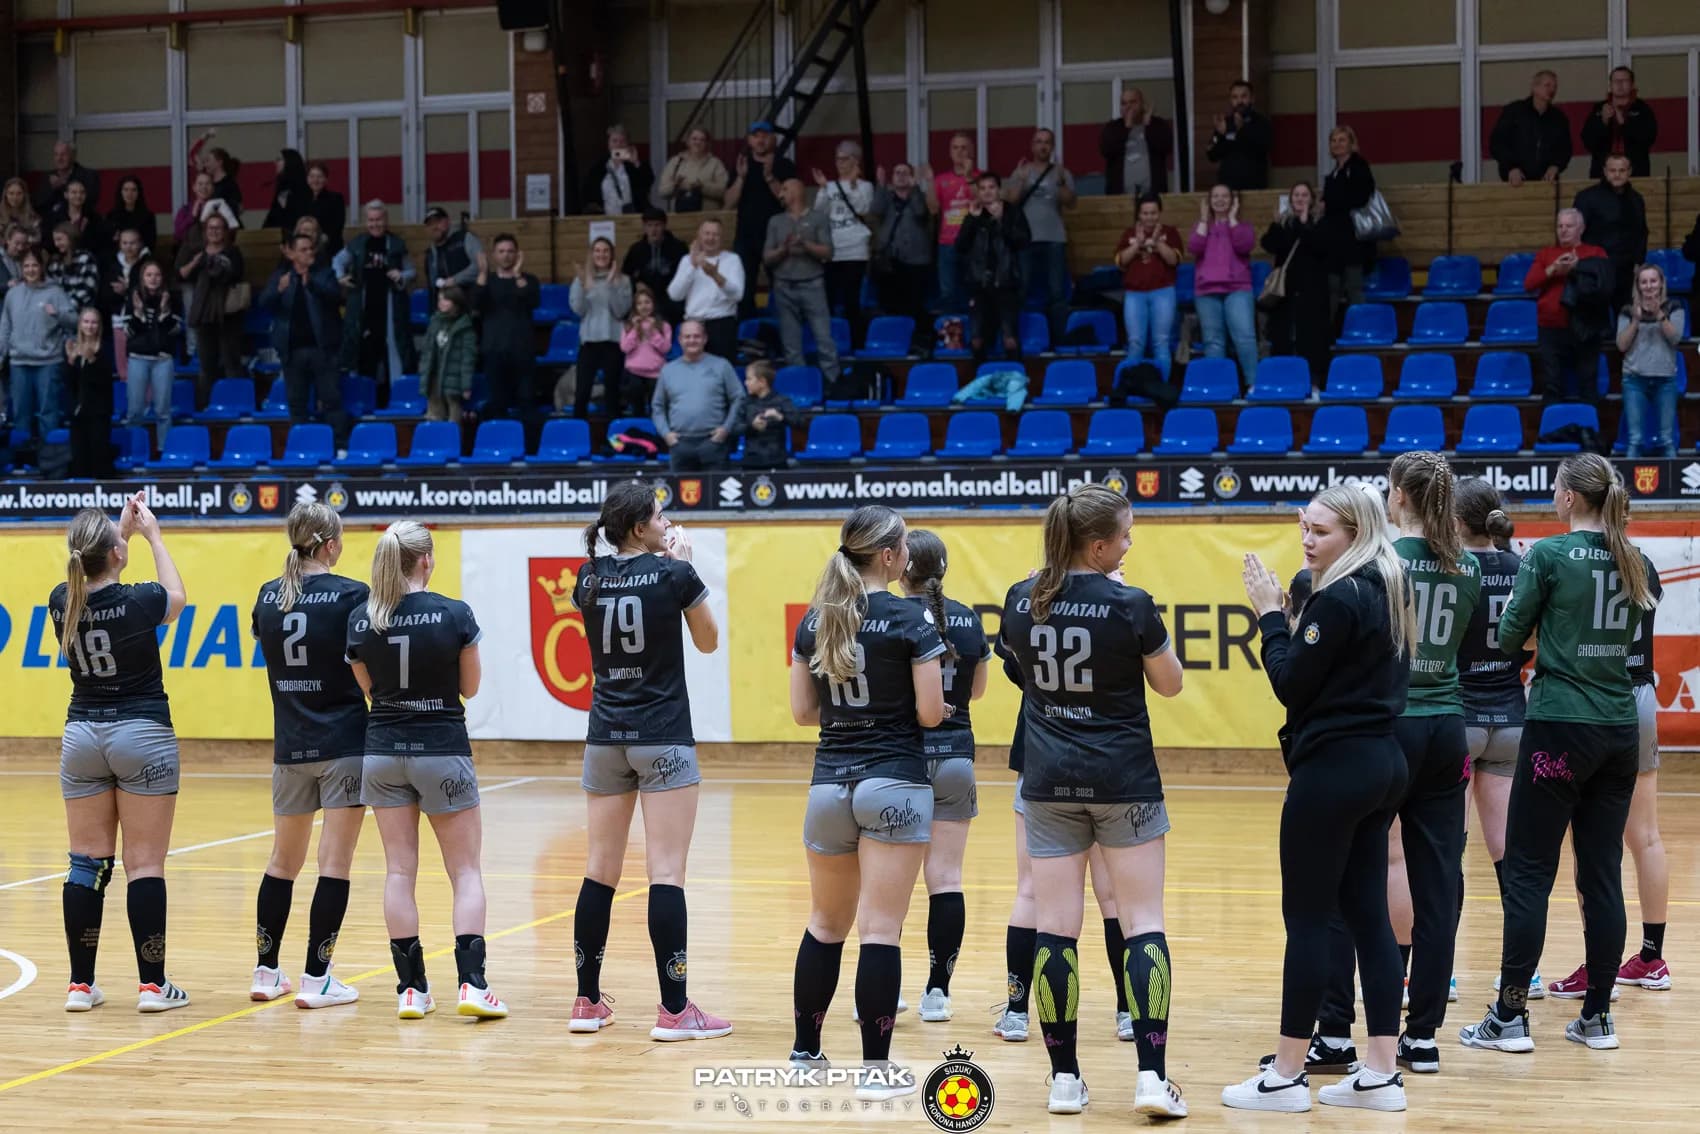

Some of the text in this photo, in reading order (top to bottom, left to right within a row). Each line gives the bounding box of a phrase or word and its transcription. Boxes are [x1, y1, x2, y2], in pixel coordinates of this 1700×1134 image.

[355, 480, 607, 507] www.koronahandball
[597, 573, 659, 588] EWIATAN
[1411, 559, 1475, 577] LEWTAN
[1481, 574, 1517, 587] EWIAT
[597, 596, 645, 653] 79
[1051, 601, 1111, 619] WIATAN
[1415, 581, 1457, 646] 16
[1592, 570, 1629, 630] 12
[73, 629, 117, 677] 18
[283, 612, 308, 666] 2
[387, 635, 409, 689] 7
[1030, 625, 1094, 692] 32
